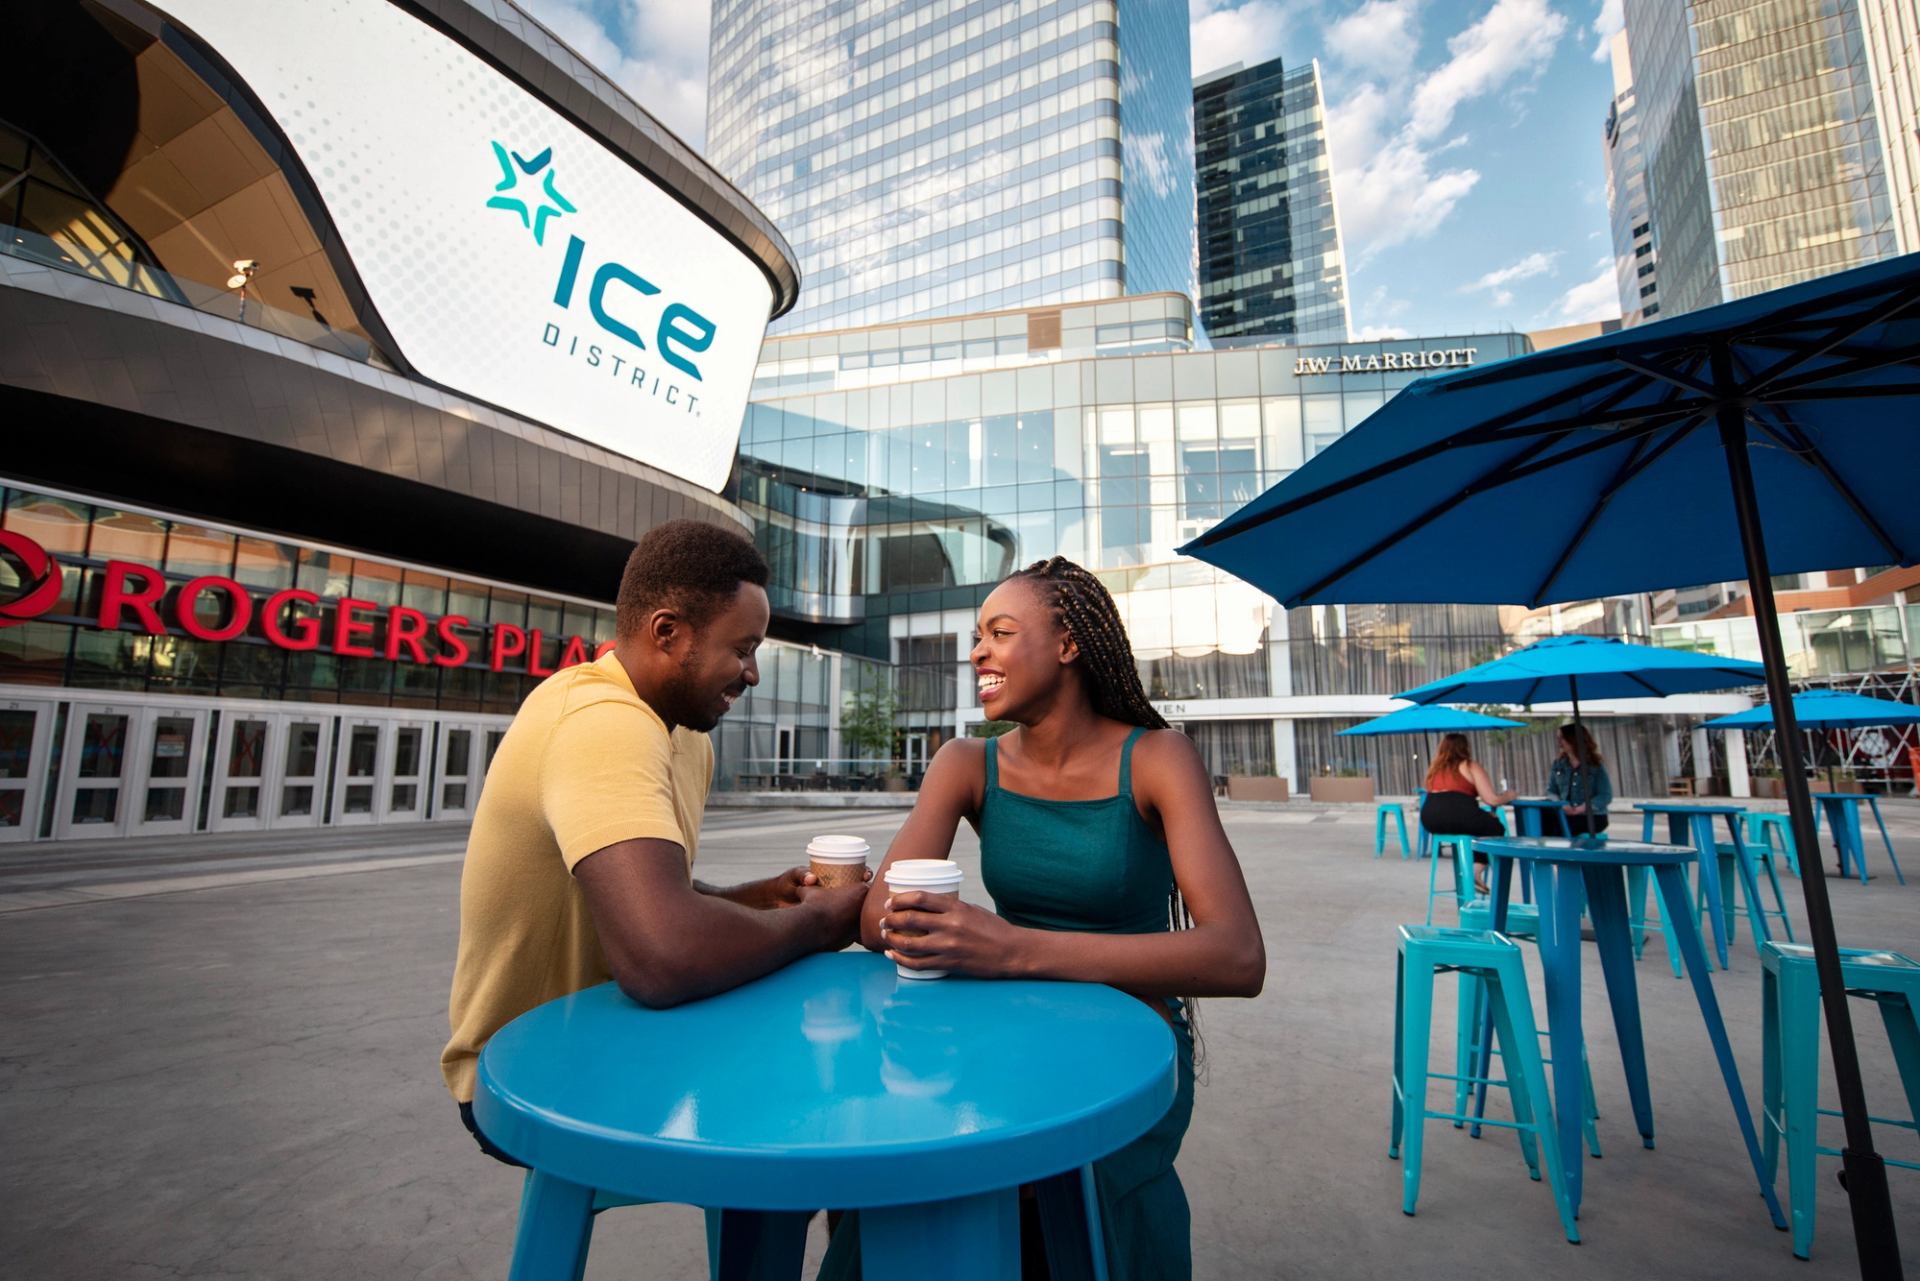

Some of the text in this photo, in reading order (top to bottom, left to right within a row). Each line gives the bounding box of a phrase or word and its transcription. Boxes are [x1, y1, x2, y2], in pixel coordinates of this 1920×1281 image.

[543, 322, 699, 414] DISTRICT
[1294, 347, 1477, 375] JW MARRIOTT
[97, 559, 470, 668] ROGERS
